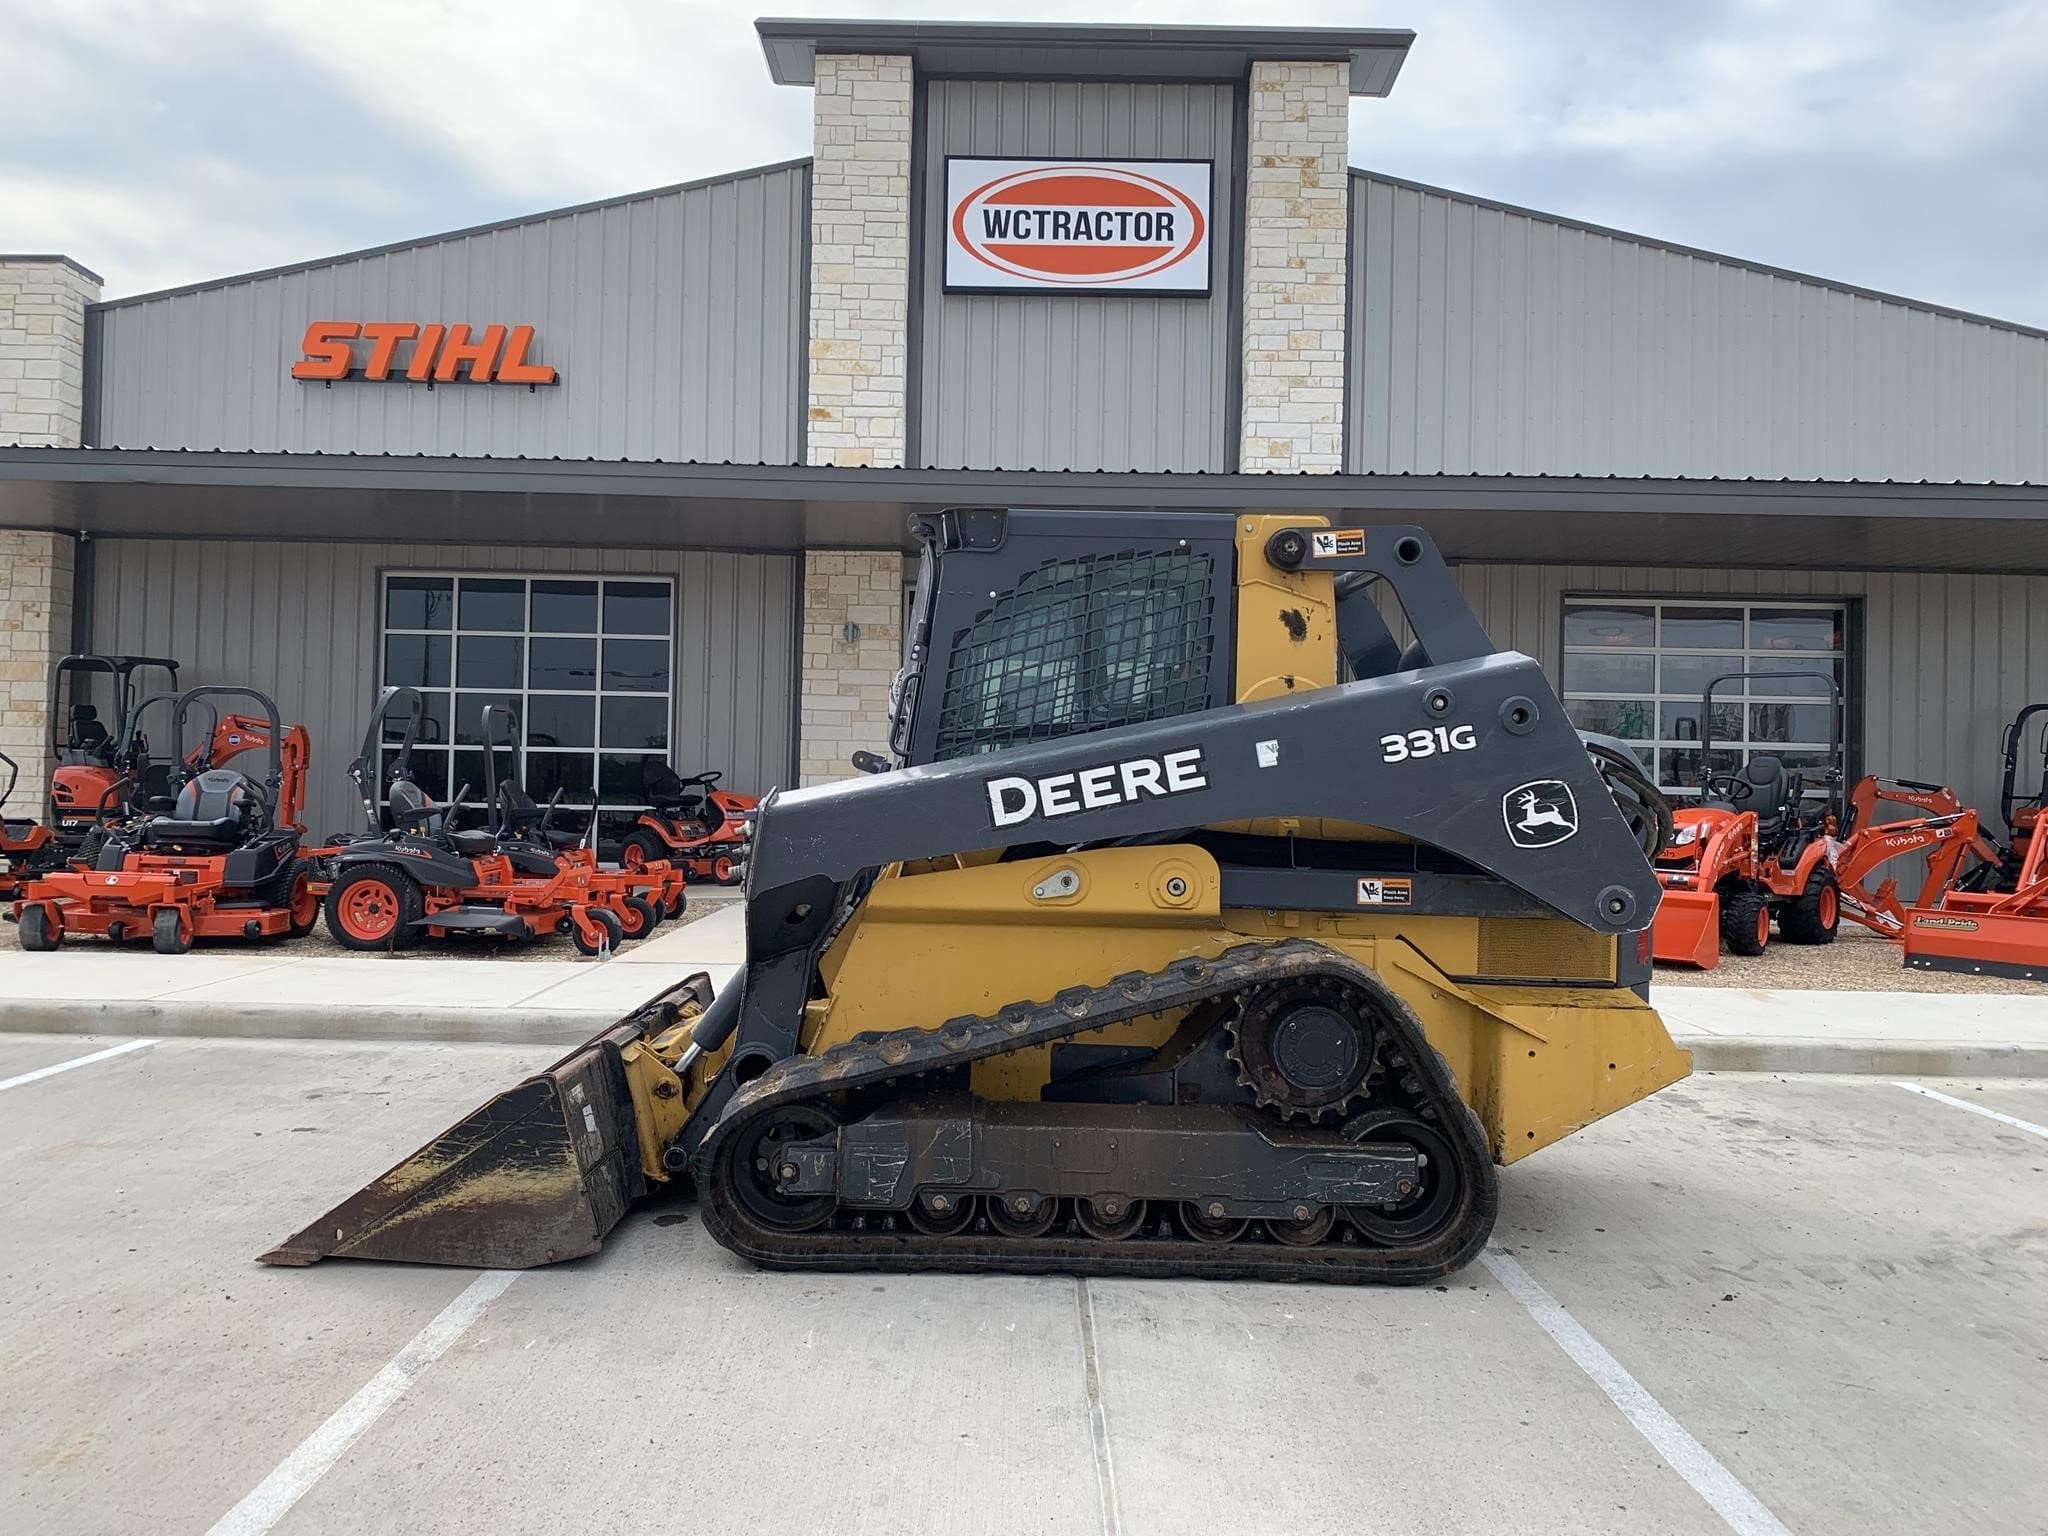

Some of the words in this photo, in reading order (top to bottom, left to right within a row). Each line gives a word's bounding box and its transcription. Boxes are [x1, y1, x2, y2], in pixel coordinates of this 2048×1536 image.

[982, 208, 1175, 242] WCTRACTOR
[292, 321, 557, 384] STIHL
[1380, 725, 1477, 763] 331G
[987, 748, 1207, 827] DEERE
[1885, 834, 1925, 848] Kubota
